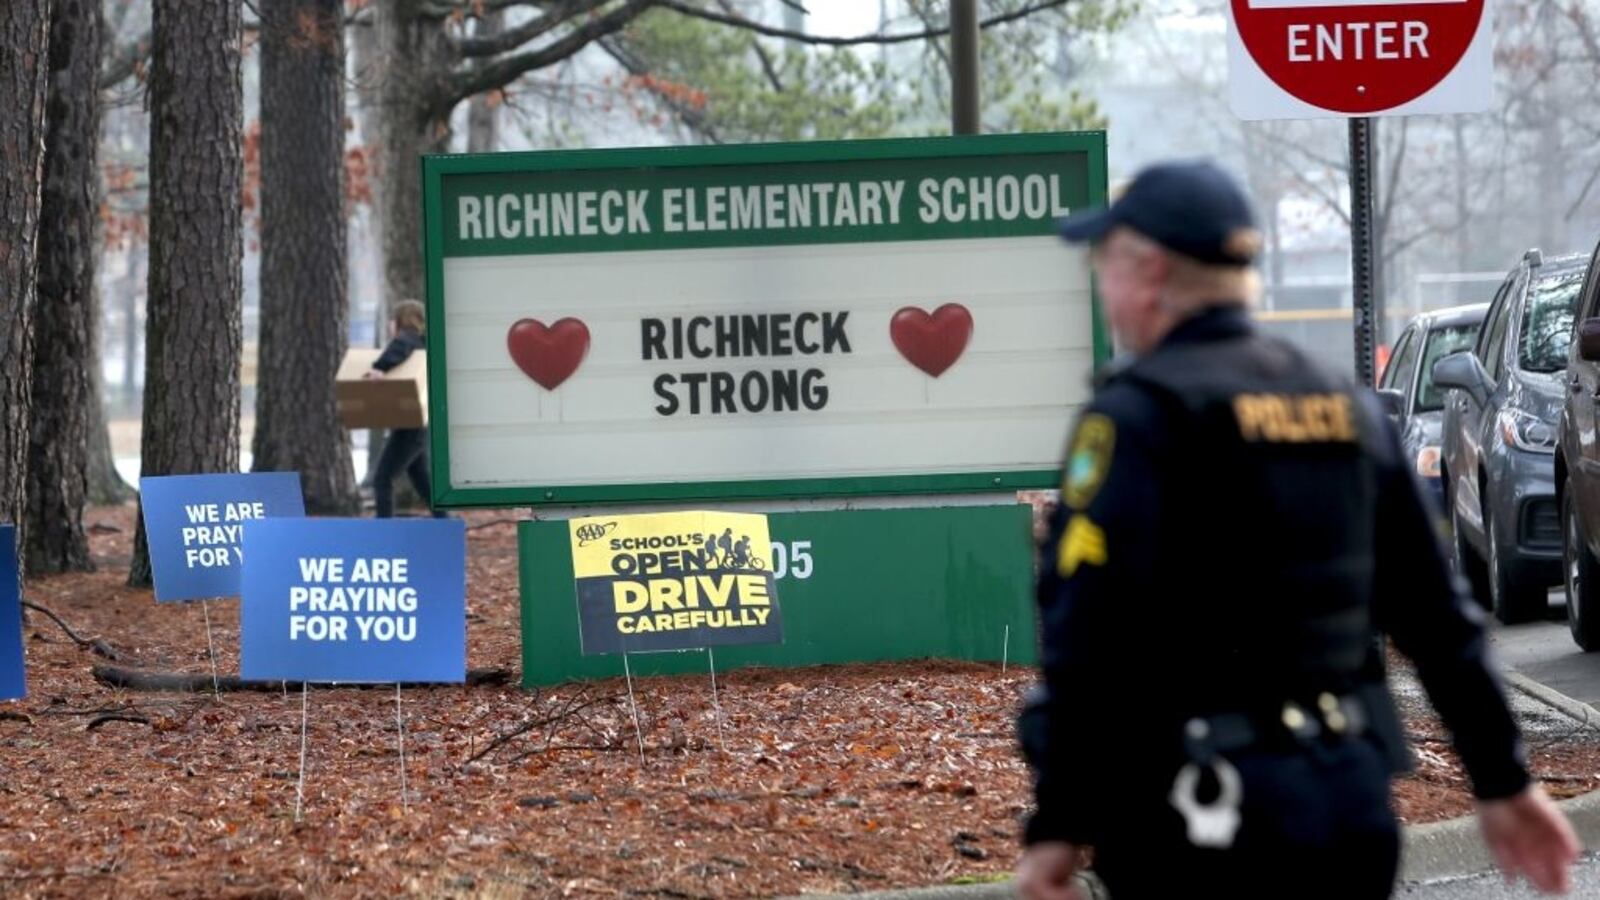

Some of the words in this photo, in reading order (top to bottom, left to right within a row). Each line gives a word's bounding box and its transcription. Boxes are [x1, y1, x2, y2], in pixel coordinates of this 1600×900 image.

[1288, 20, 1430, 62] ENTER
[458, 189, 652, 240] RICHNECK
[662, 180, 906, 232] ELEMENTARY
[918, 173, 1070, 224] SCHOOL
[641, 311, 852, 360] RICHNECK
[653, 368, 829, 416] STRONG
[1234, 392, 1356, 443] POLICE
[185, 503, 220, 524] WE
[225, 502, 266, 521] ARE
[610, 533, 704, 551] SCHOOL'S
[186, 547, 230, 569] FOR
[298, 557, 344, 583] WE
[350, 557, 408, 583] ARE
[611, 547, 706, 576] OPEN
[289, 586, 418, 613] PRAYING
[612, 573, 771, 614] DRIVE
[289, 614, 348, 641] FOR
[354, 615, 417, 641] YOU
[616, 607, 771, 634] CAREFULLY
